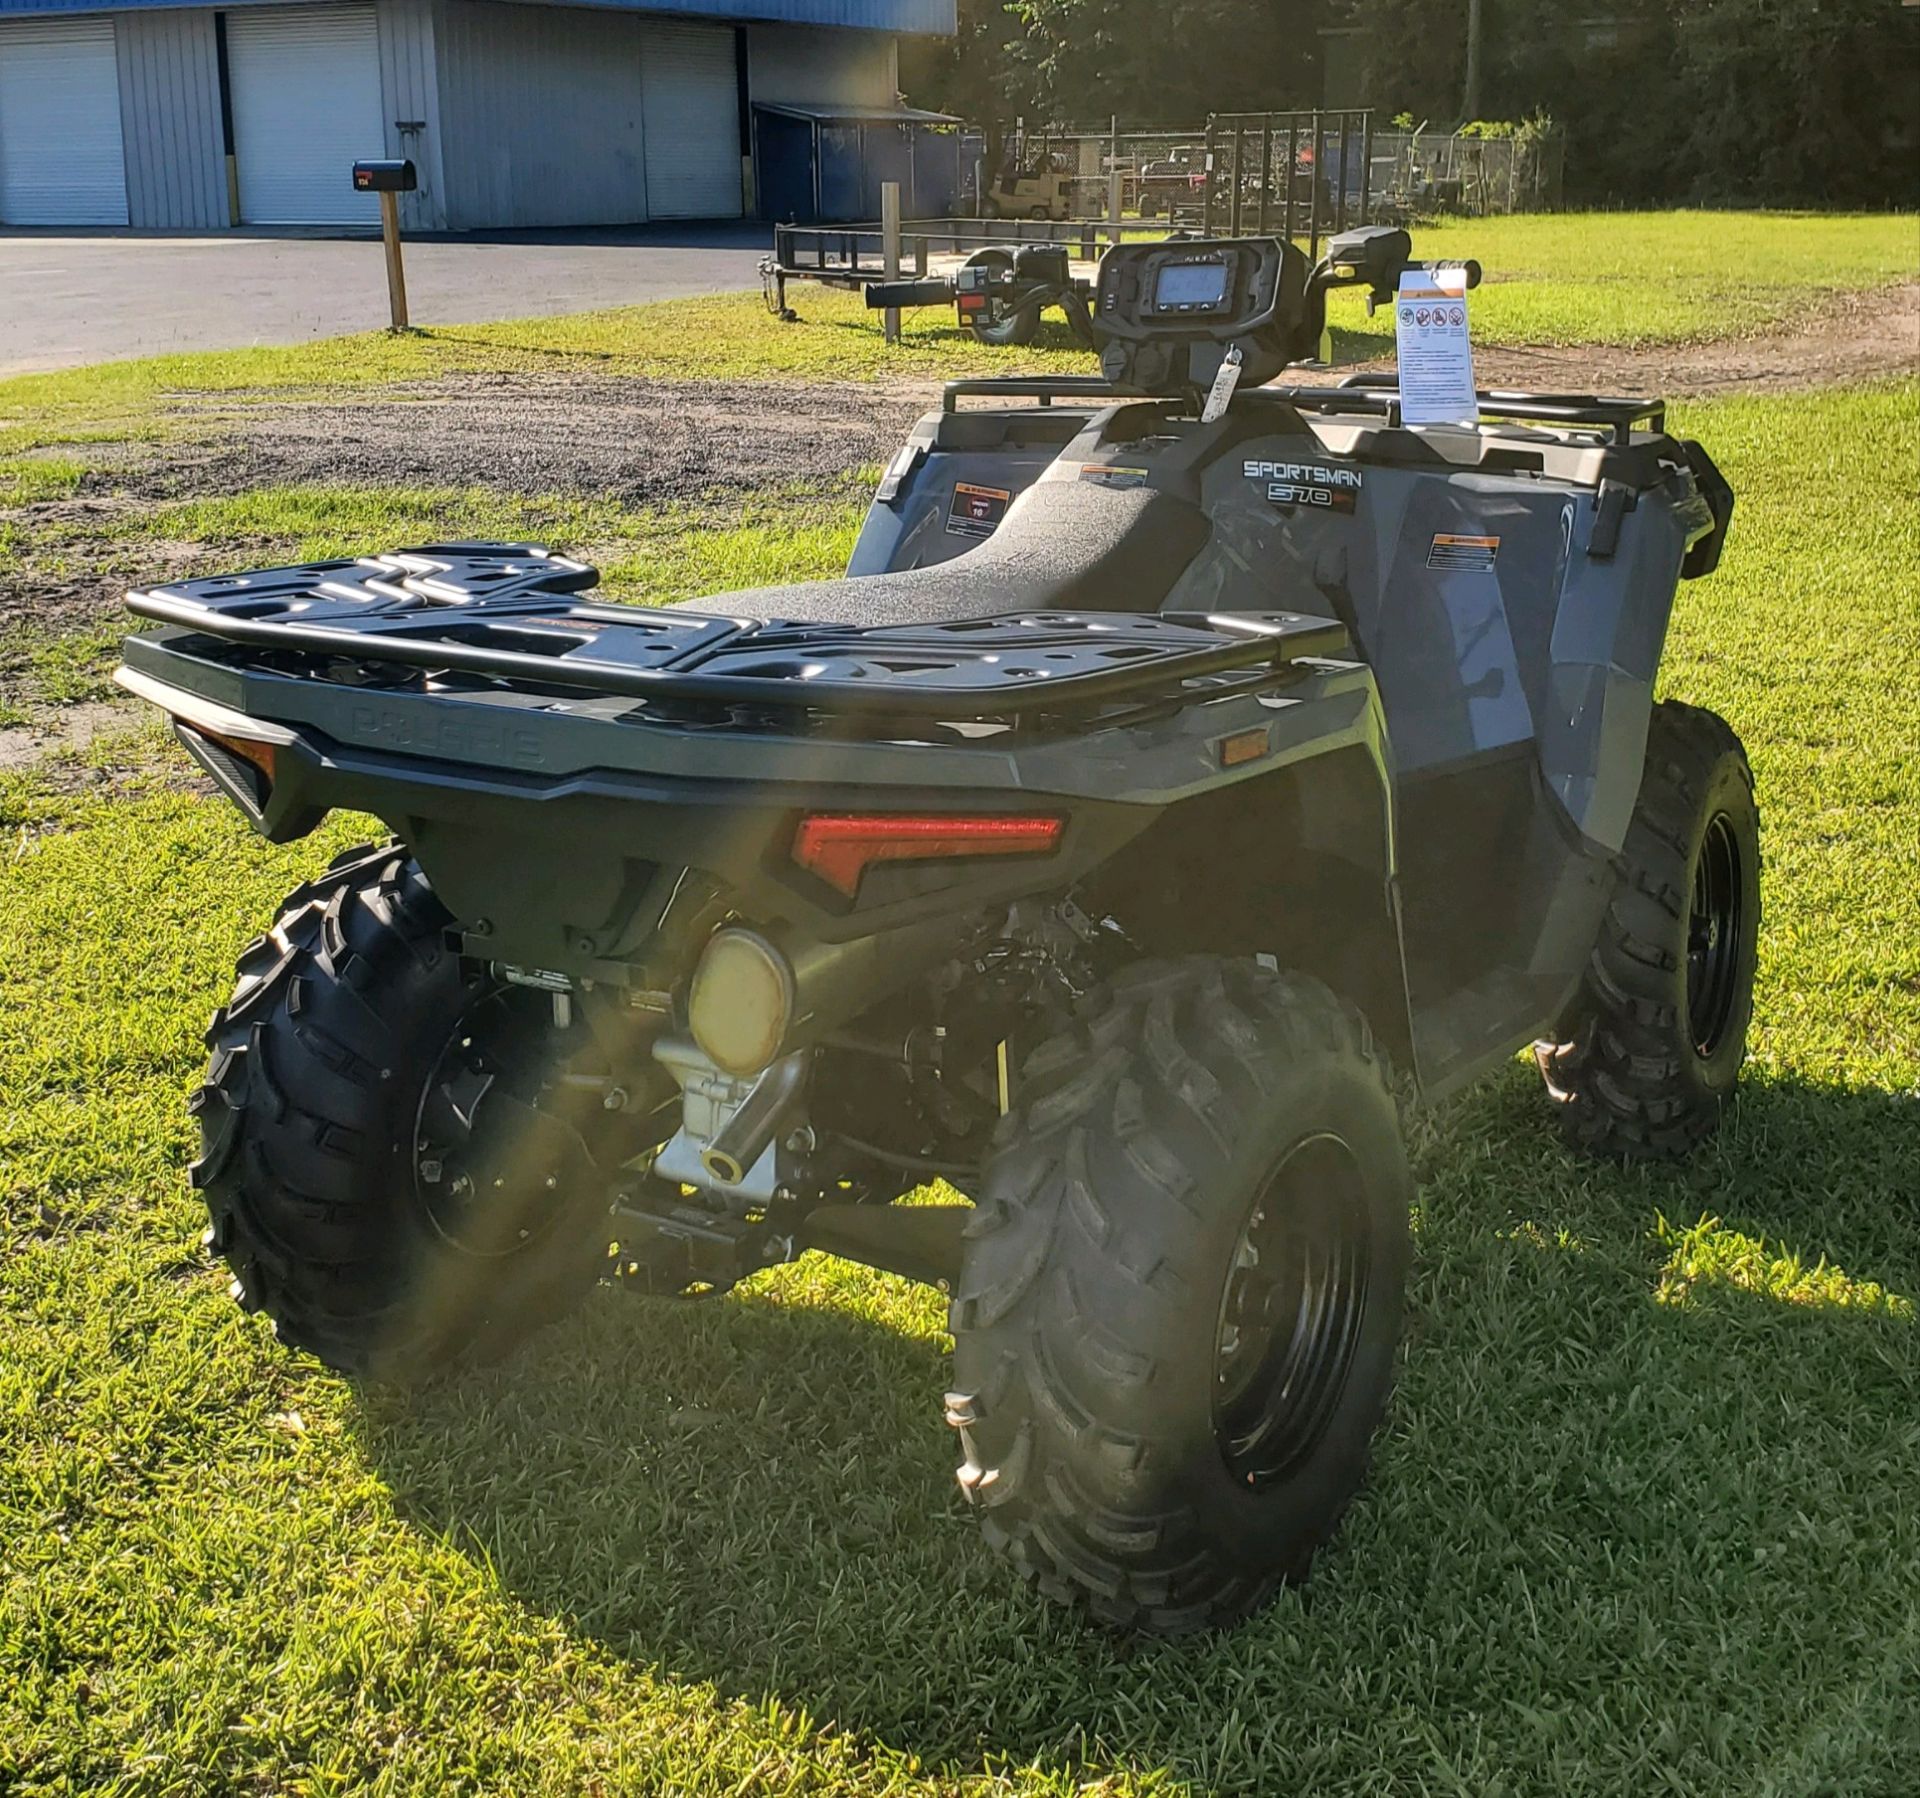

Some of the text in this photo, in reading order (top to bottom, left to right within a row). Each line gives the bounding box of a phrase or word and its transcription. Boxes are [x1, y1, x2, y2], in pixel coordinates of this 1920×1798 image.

[1243, 460, 1363, 488] SPORTSMAN
[1267, 482, 1333, 507] 570
[352, 706, 546, 764] POLARIS
